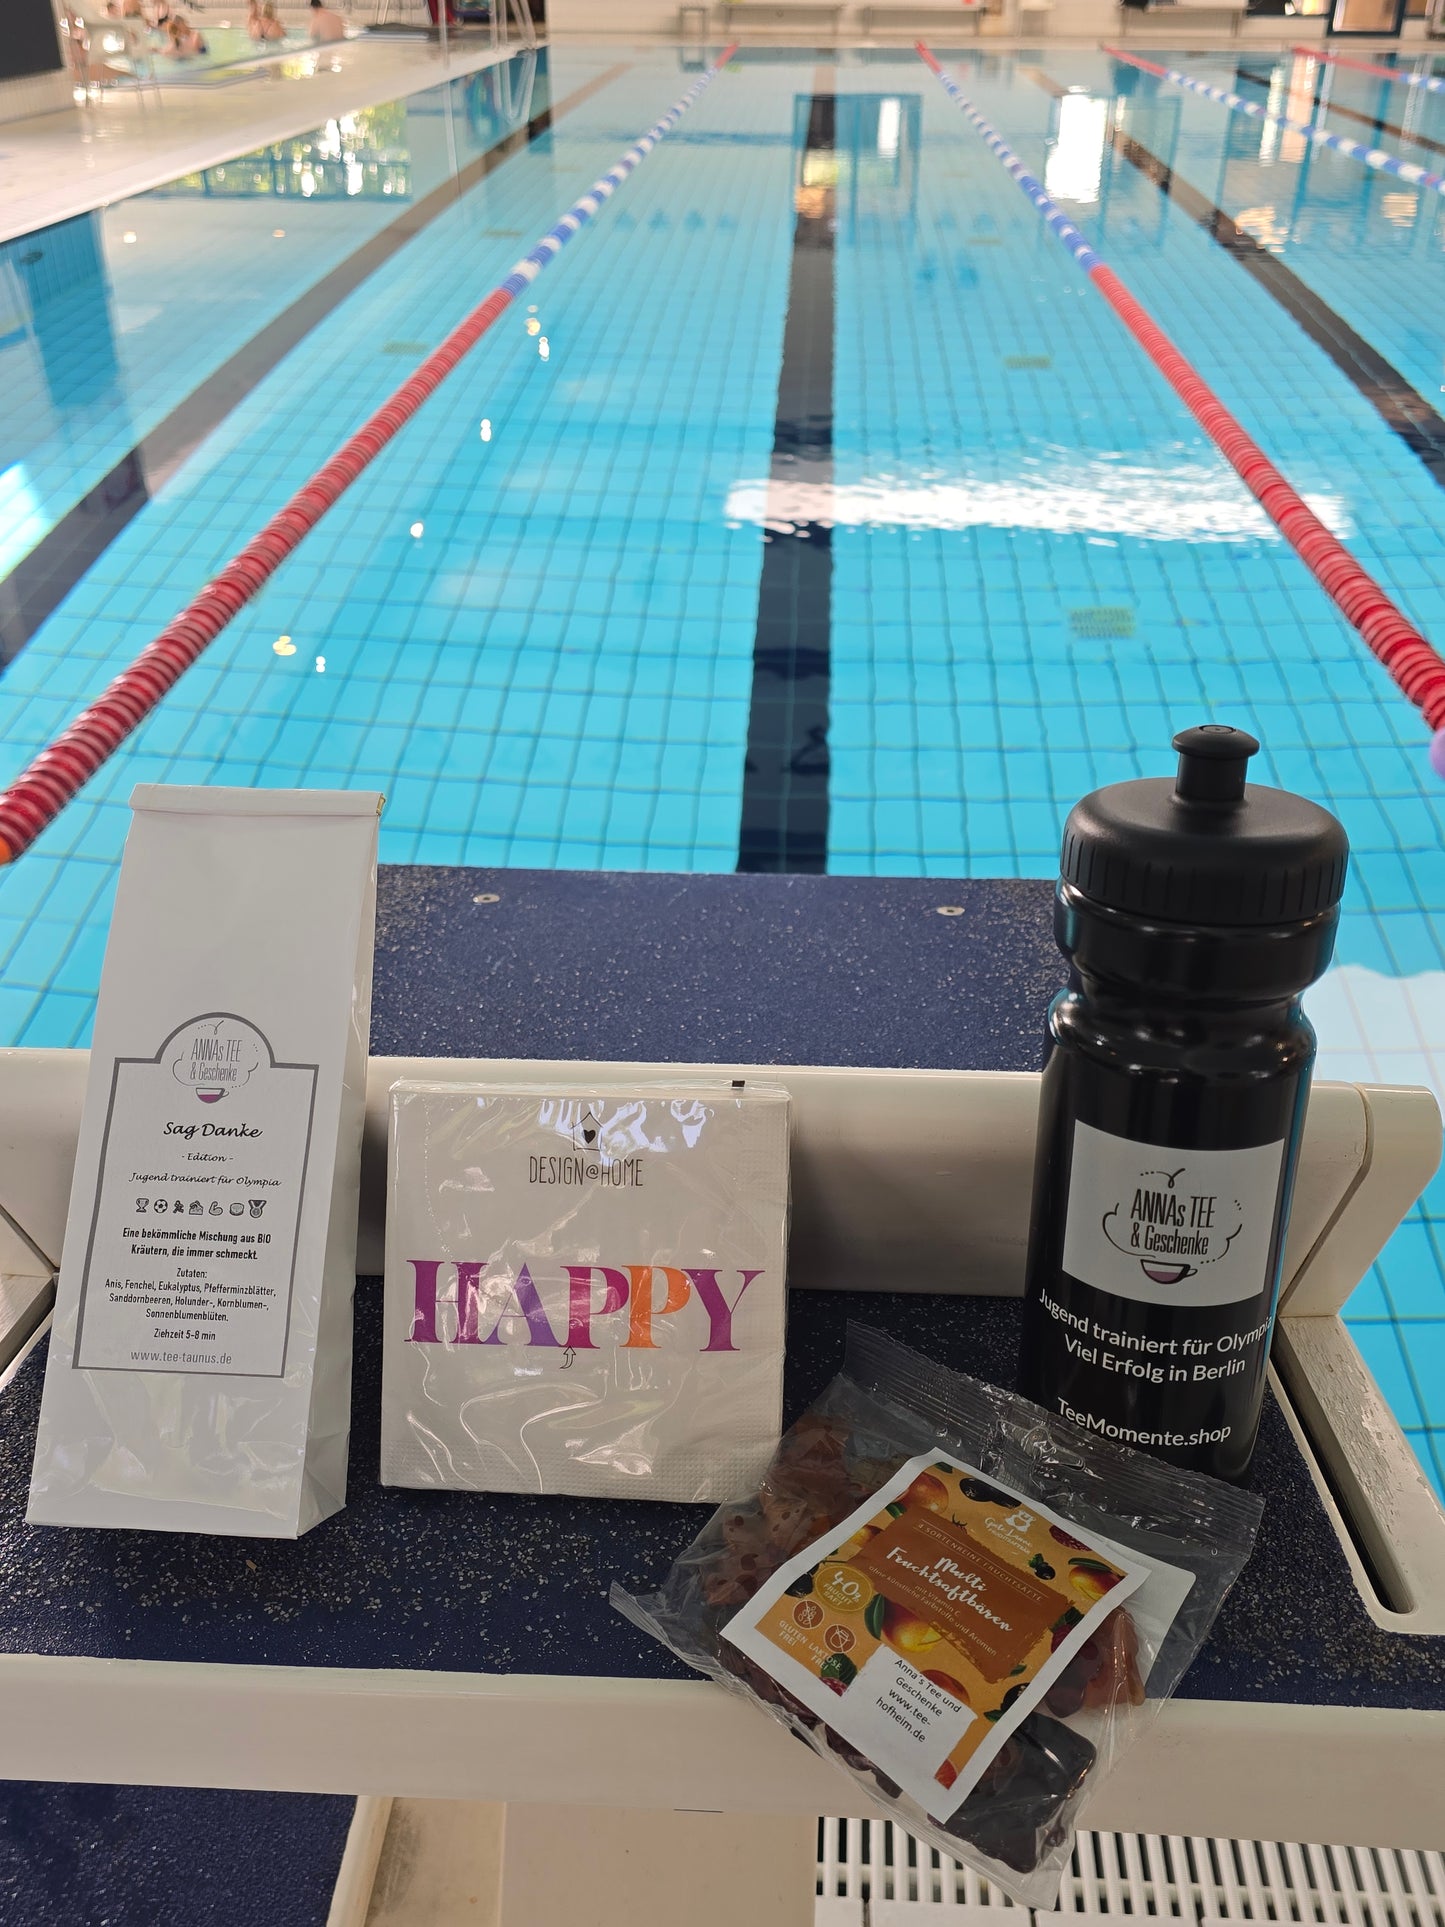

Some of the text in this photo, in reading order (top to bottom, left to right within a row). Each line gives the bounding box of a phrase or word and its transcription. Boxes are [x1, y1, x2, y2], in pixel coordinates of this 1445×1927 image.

[191, 1039, 242, 1062] ANNAs TEE
[190, 1063, 237, 1081] & Geschenke
[163, 1122, 263, 1140] Sag Danke
[187, 1153, 227, 1162] Edition
[129, 1173, 282, 1187] Jugend trainiert für Olympia
[529, 1155, 643, 1187] DESIGN@HOME
[1130, 1189, 1217, 1228] ANNAs TEE
[123, 1228, 271, 1244] Eine bekömmliche Mischung aus BIO
[1131, 1223, 1209, 1255] & Geschenke
[131, 1244, 258, 1259] Kräutern, die immer schmeckt.
[177, 1268, 207, 1279] Zutaten:
[105, 1279, 276, 1297] Anis, Fenchel, Eukalyptus, Pfefferminzblätter,
[109, 1294, 269, 1310] Sanddornbeeren, Holunder-, Kornblumen-,
[404, 1259, 766, 1352] HAPPY
[146, 1309, 229, 1321] Sonnenblumenblüten.
[1039, 1288, 1089, 1333] Jugend
[1093, 1323, 1178, 1355] trainiert
[1182, 1339, 1213, 1355] für
[154, 1328, 216, 1340] Ziehzeit 5-8 min
[130, 1351, 232, 1364] www.tee-taunus.de
[1064, 1333, 1245, 1383] Viel Erfolg in Berlin
[1057, 1397, 1231, 1446] TeeMomente.shop
[934, 1557, 987, 1593] Multi
[823, 1583, 853, 1605] FRUCHT
[886, 1547, 1013, 1633] Fruchtsaftbären
[914, 1584, 928, 1594] mit
[927, 1589, 955, 1612] Vitamin
[778, 1620, 807, 1644] GLUTEN
[778, 1630, 796, 1646] FREI
[954, 1619, 970, 1633] und
[969, 1632, 998, 1656] Aromen
[808, 1643, 842, 1671] LAKTOSE
[811, 1654, 829, 1670] FREI
[889, 1689, 931, 1726] www.tee-
[895, 1677, 943, 1717] Geschenke
[926, 1682, 943, 1699] Tee
[943, 1695, 962, 1713] und
[875, 1696, 926, 1743] hofheim.de
